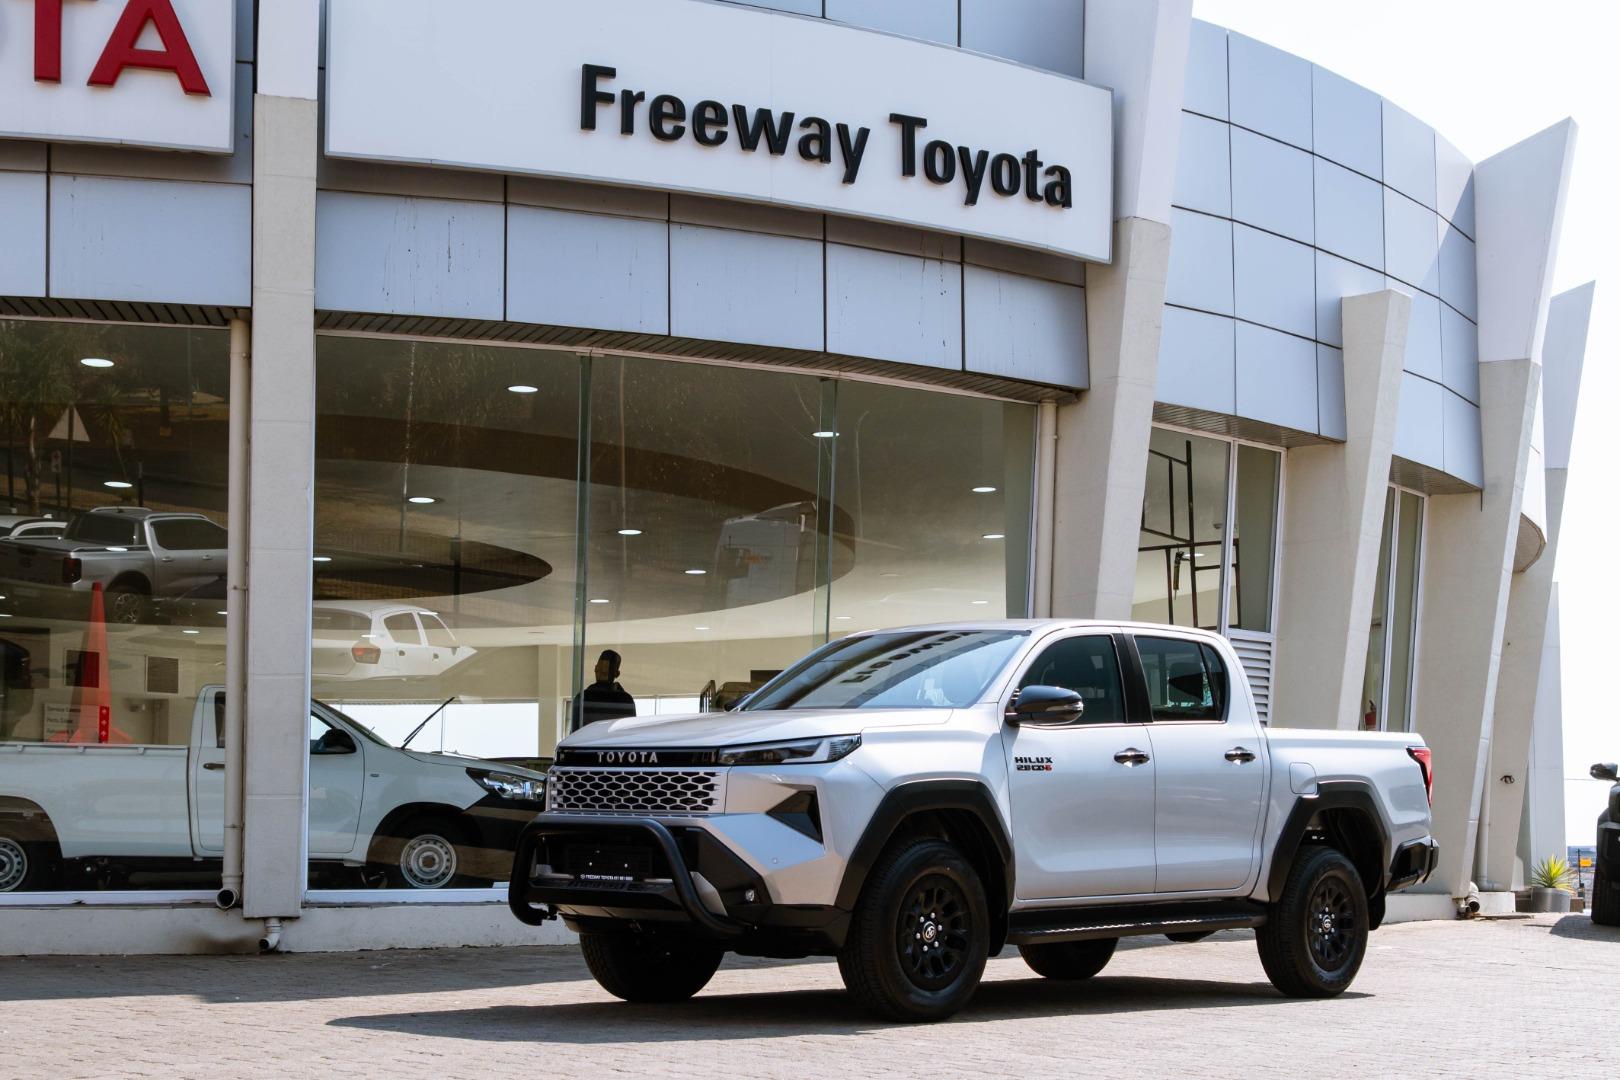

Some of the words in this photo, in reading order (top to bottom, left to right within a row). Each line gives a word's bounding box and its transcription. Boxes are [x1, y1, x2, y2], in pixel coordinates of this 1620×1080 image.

[581, 63, 871, 185] Freeway
[889, 112, 1073, 209] Toyota
[597, 751, 659, 763] TOYOTA
[1014, 756, 1053, 764] HILUX
